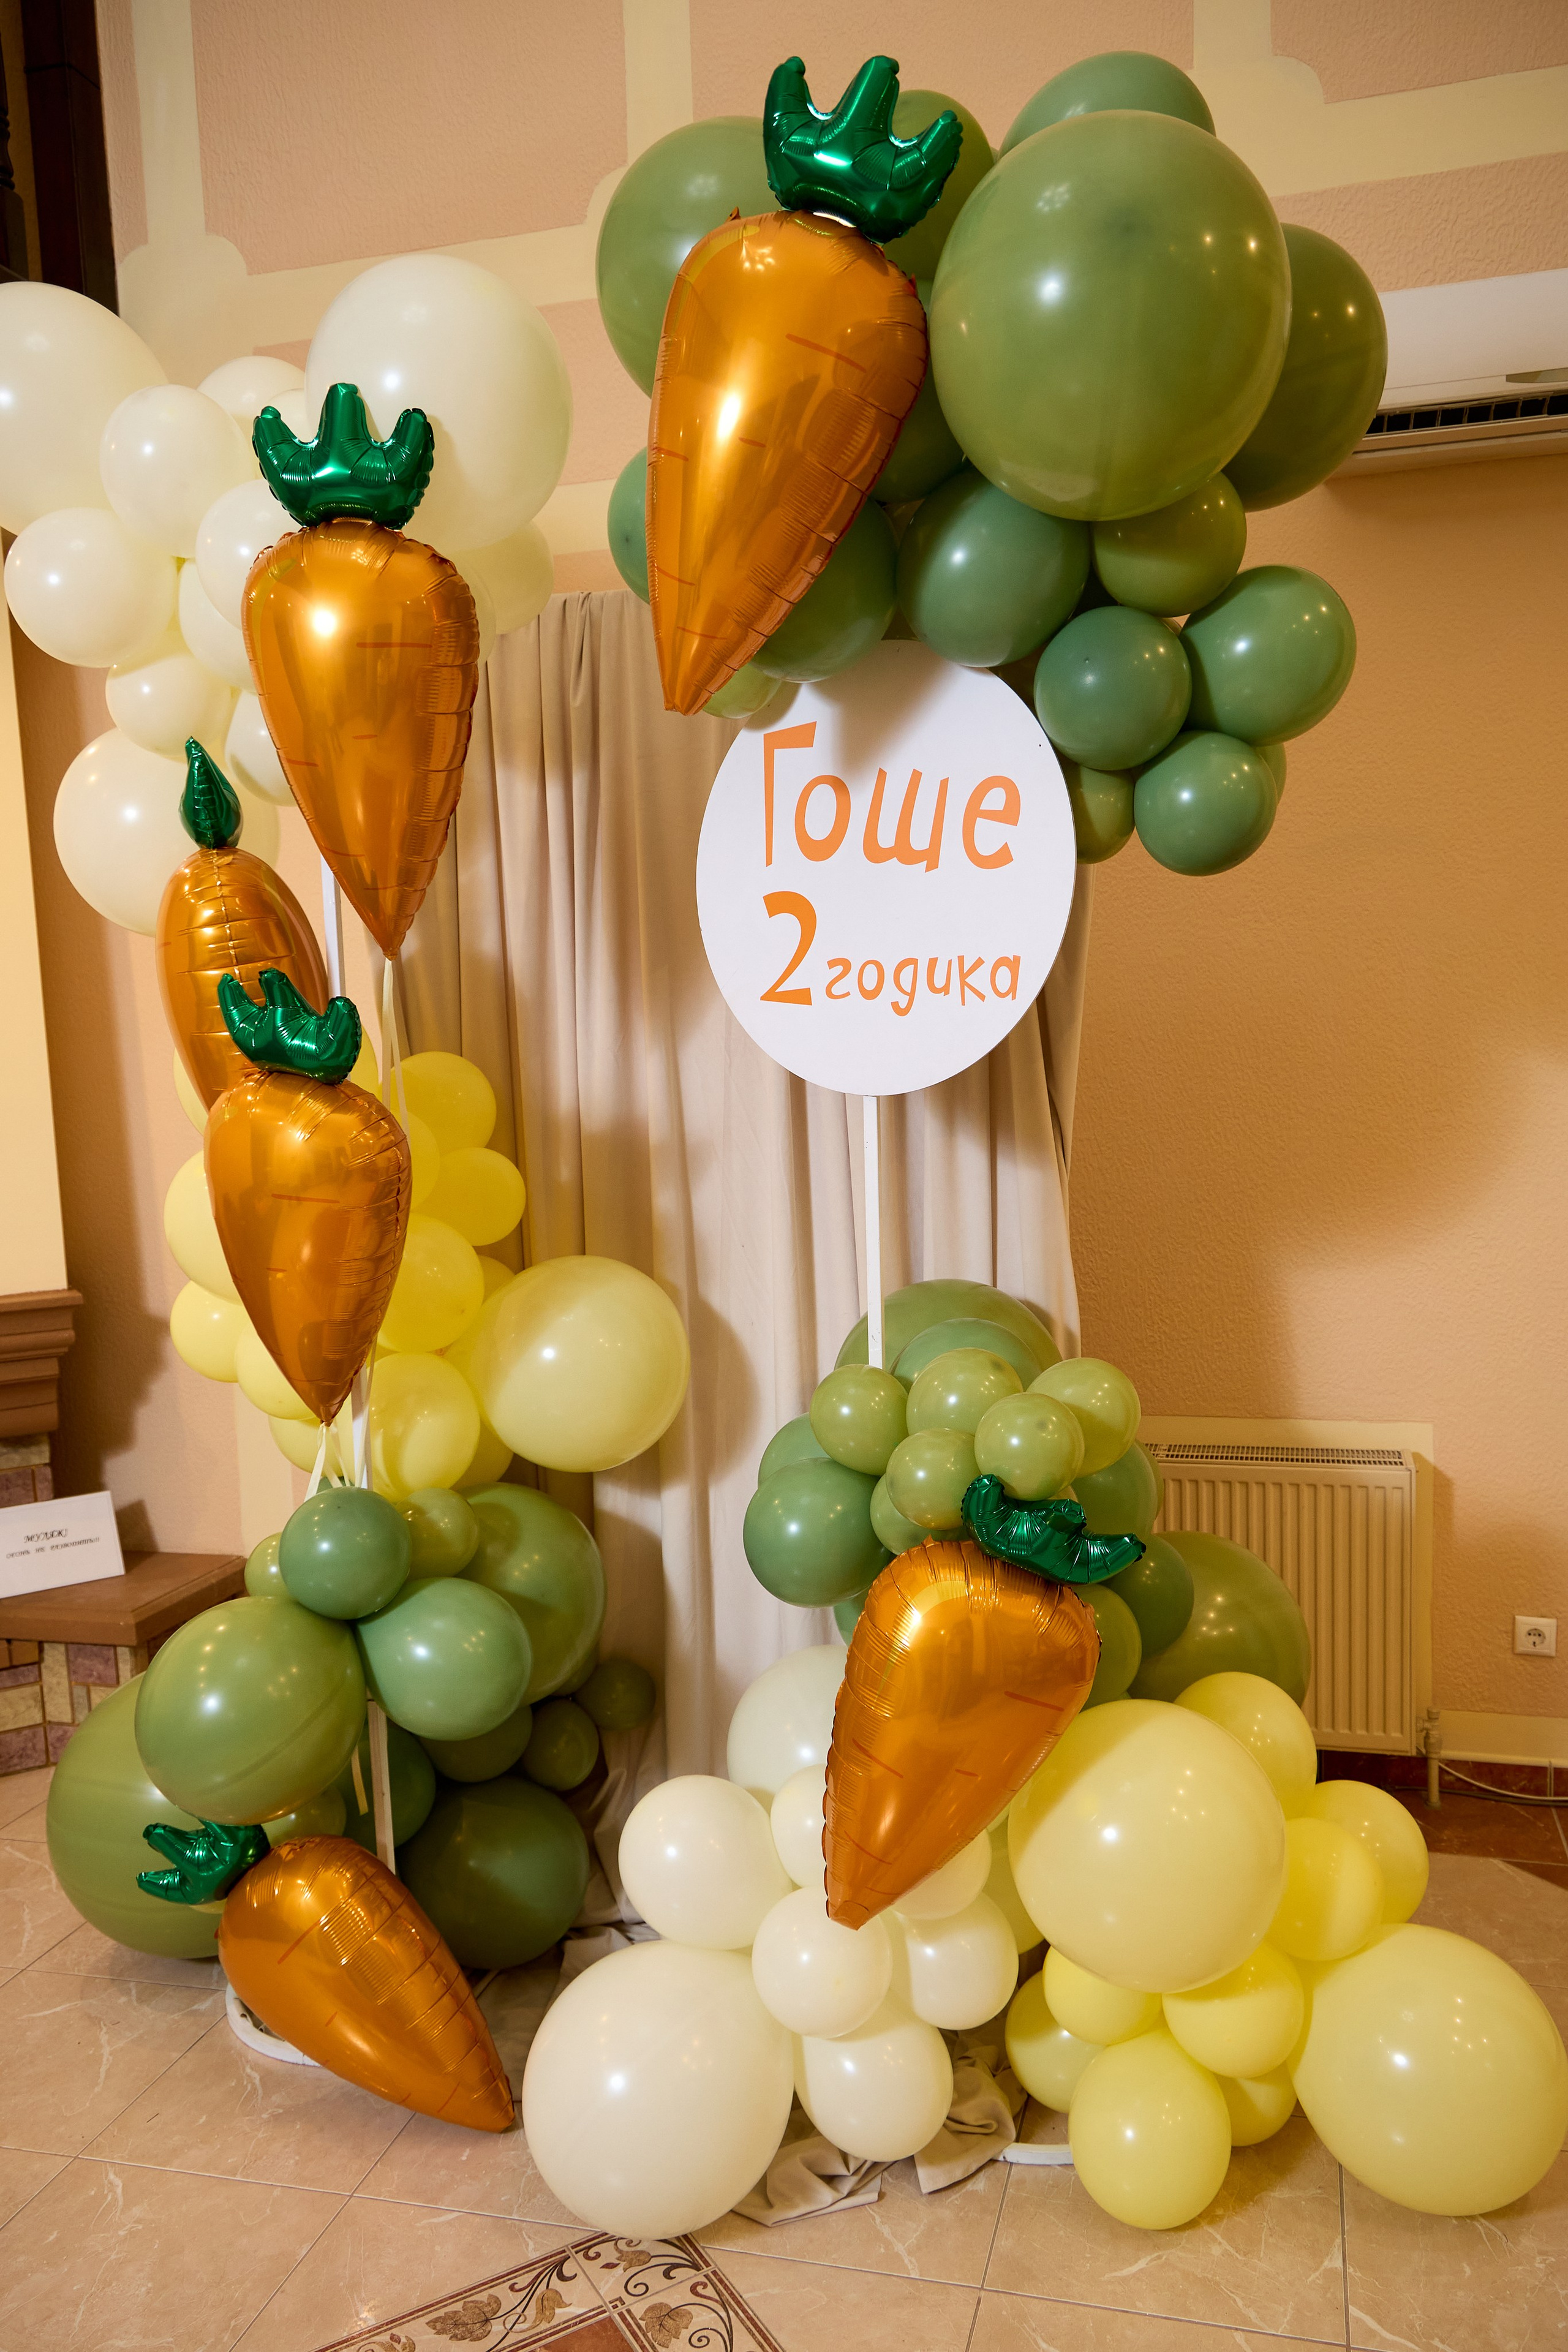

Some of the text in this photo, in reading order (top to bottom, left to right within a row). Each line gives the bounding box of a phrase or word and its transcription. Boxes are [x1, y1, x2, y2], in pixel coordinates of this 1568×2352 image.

[763, 721, 1021, 873] Гоше
[760, 891, 1021, 1017] 2 годика
